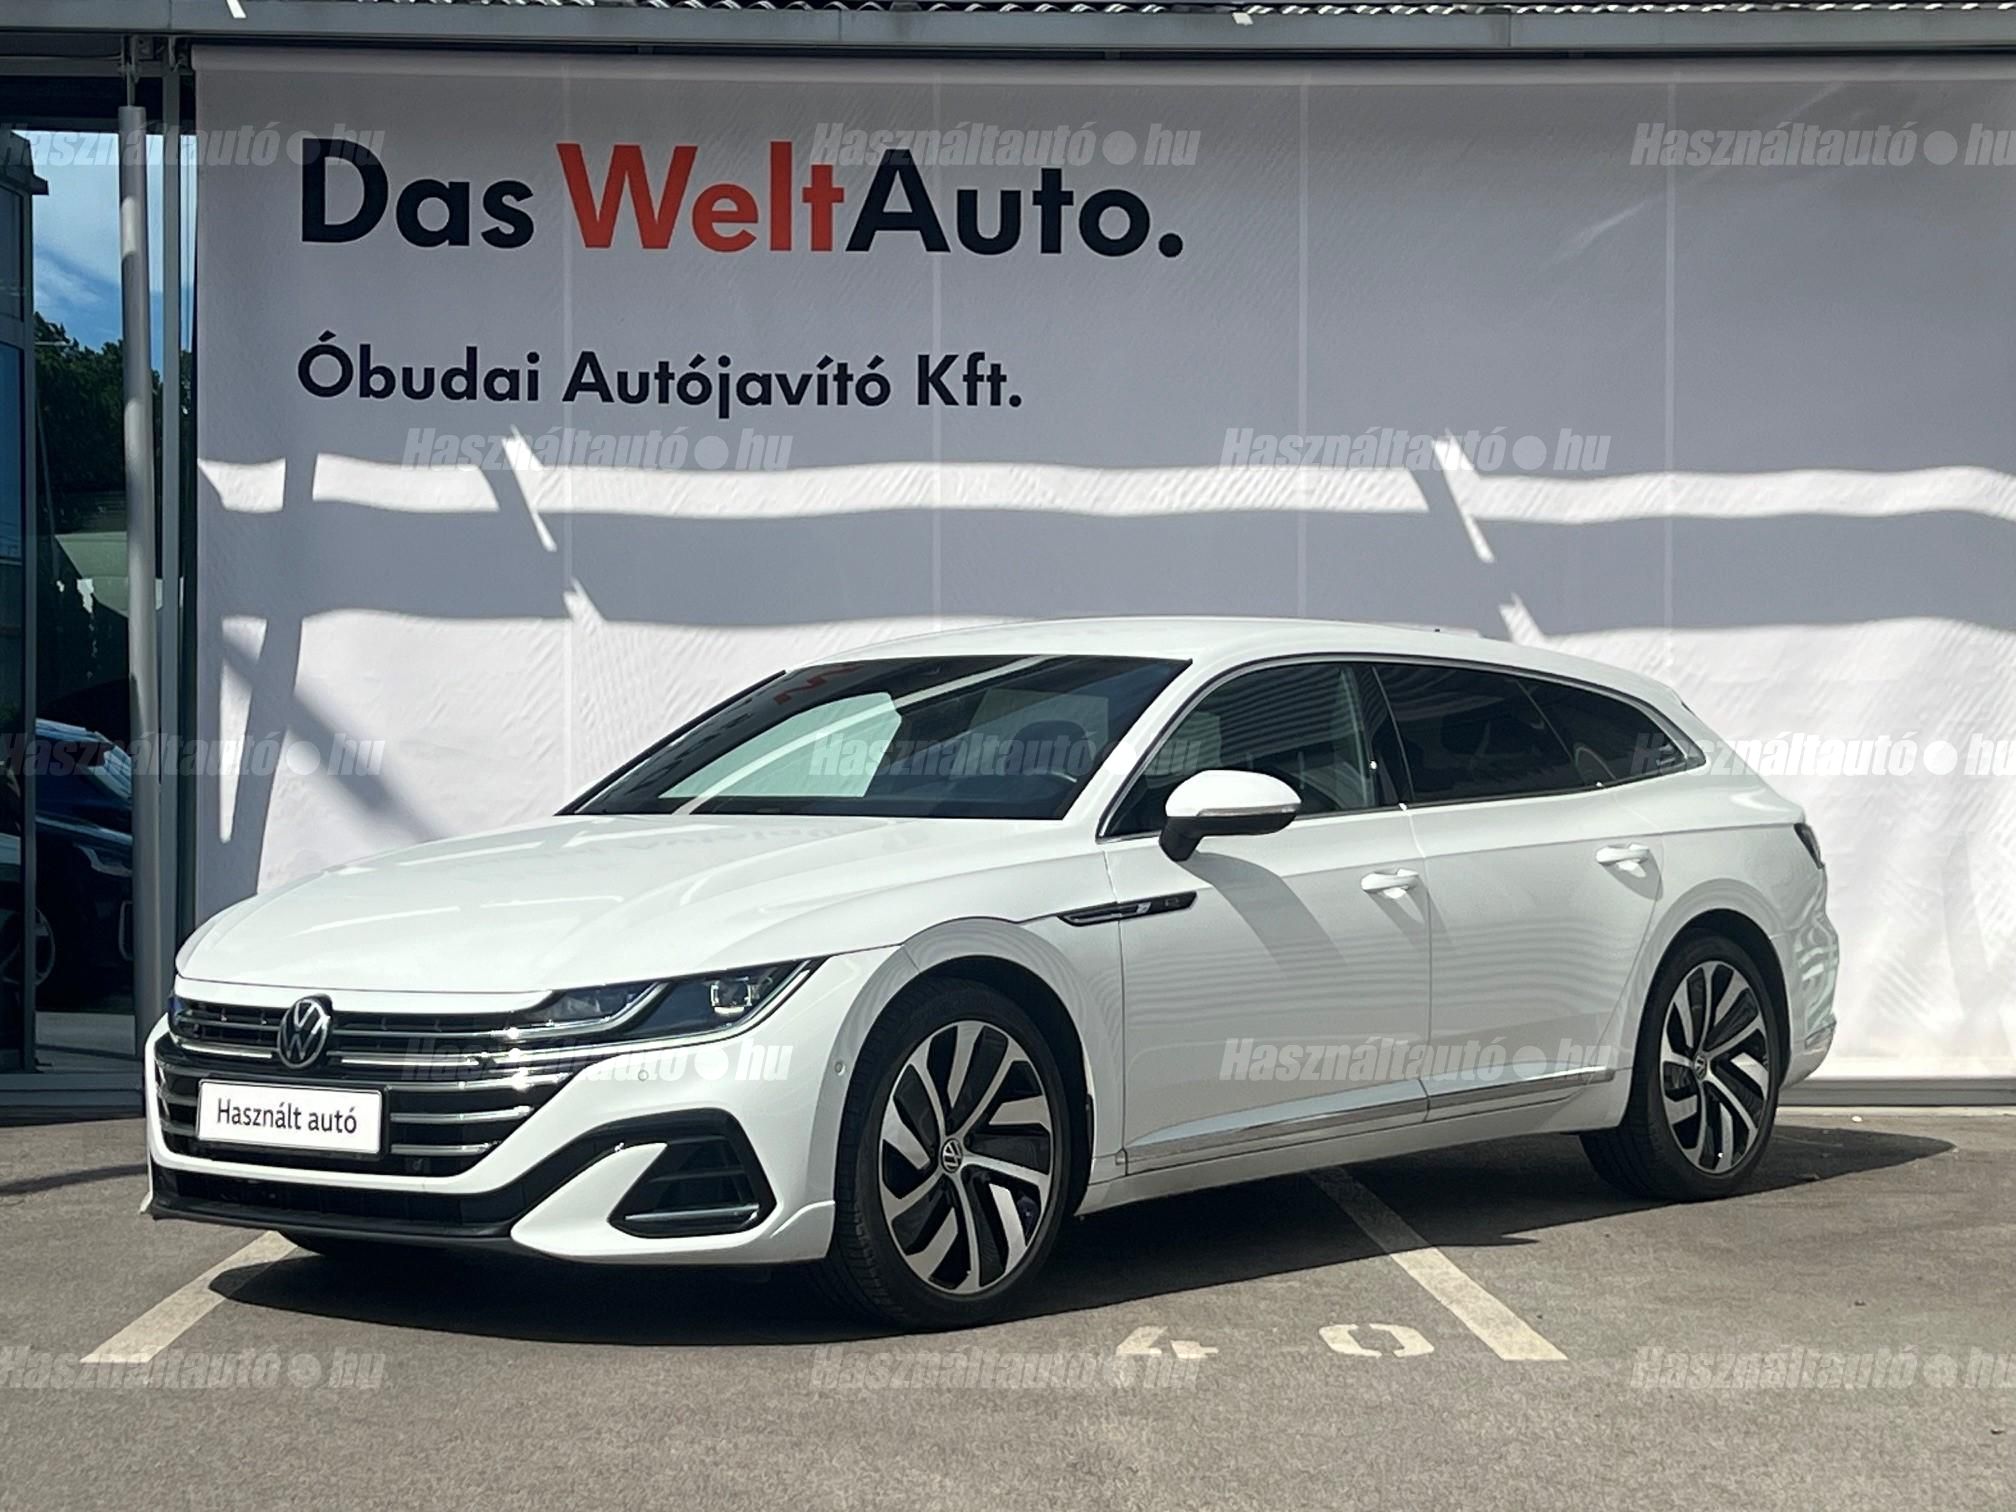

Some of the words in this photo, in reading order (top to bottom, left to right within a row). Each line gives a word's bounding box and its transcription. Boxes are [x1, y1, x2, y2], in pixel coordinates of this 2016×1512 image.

[301, 137, 534, 249] Das
[556, 140, 1184, 258] WeltAuto.
[297, 329, 540, 402] Óbudai
[561, 350, 891, 420] Autójavító
[917, 351, 1022, 408] Kft.
[216, 1098, 302, 1130] Használt
[308, 1107, 357, 1134] autó
